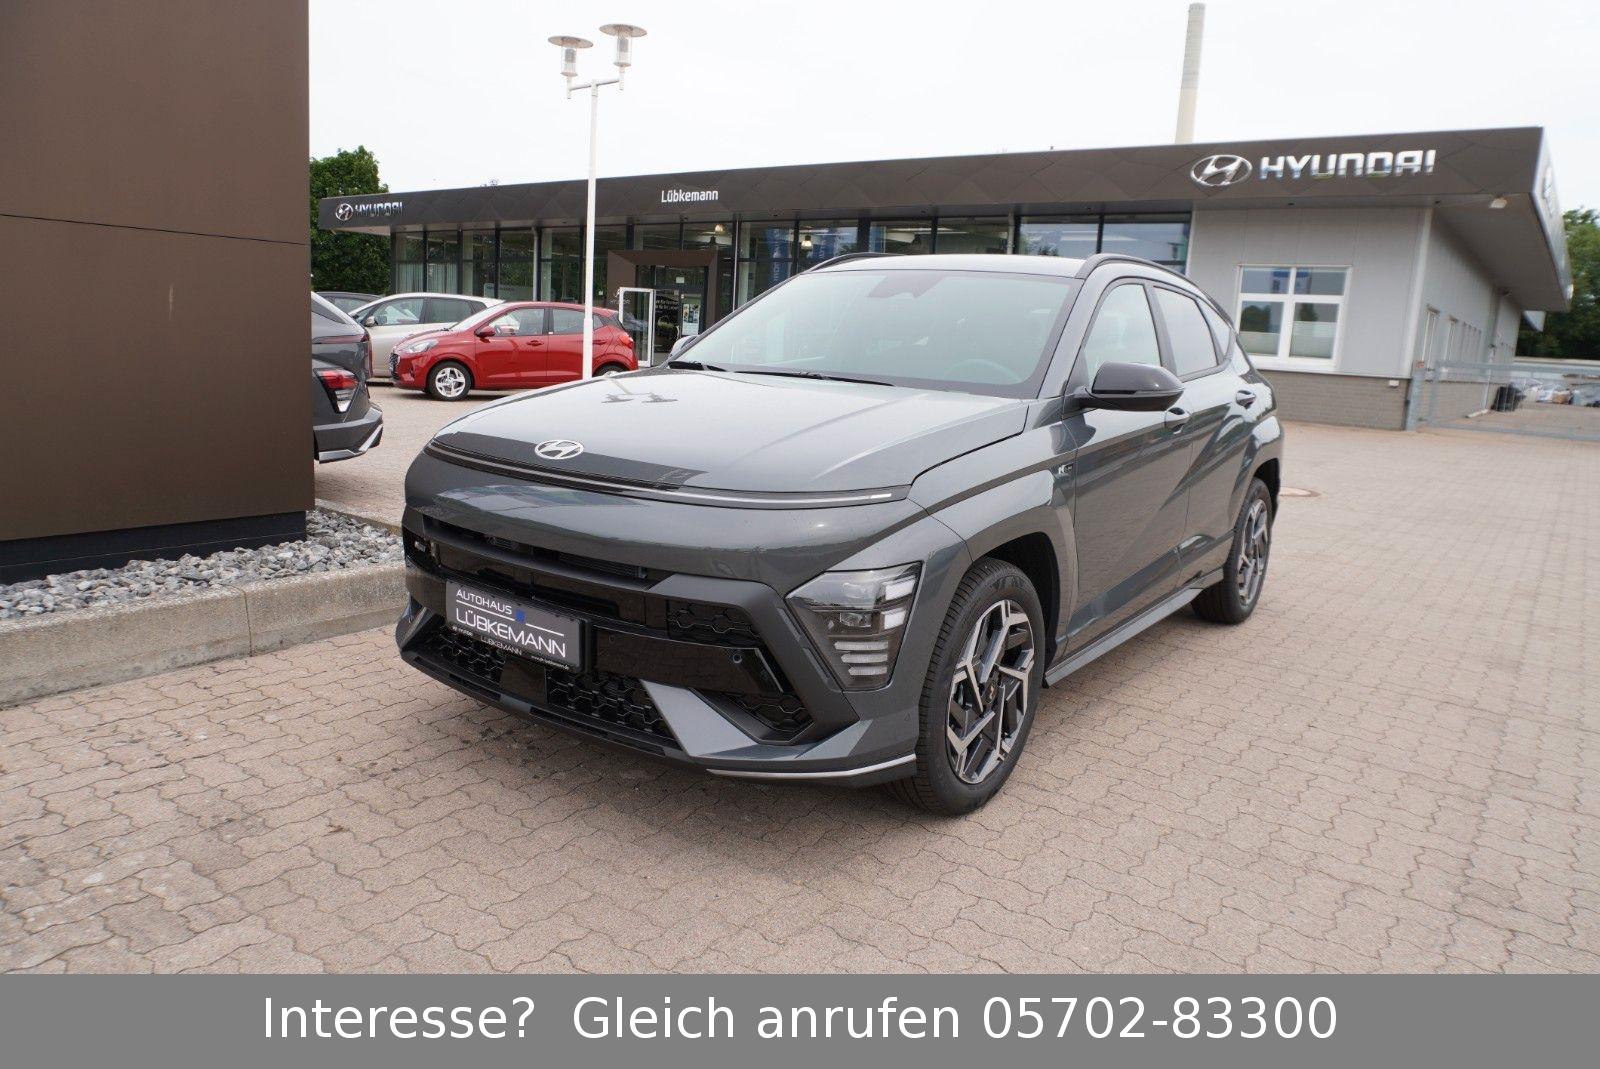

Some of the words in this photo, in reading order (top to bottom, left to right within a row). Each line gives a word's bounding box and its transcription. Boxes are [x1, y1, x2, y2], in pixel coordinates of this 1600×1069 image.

[1260, 149, 1437, 180] HYUNDAI
[661, 189, 719, 203] Lübkemann
[456, 589, 513, 615] AUTOHAUS
[456, 607, 566, 658] LÜBKEMANN
